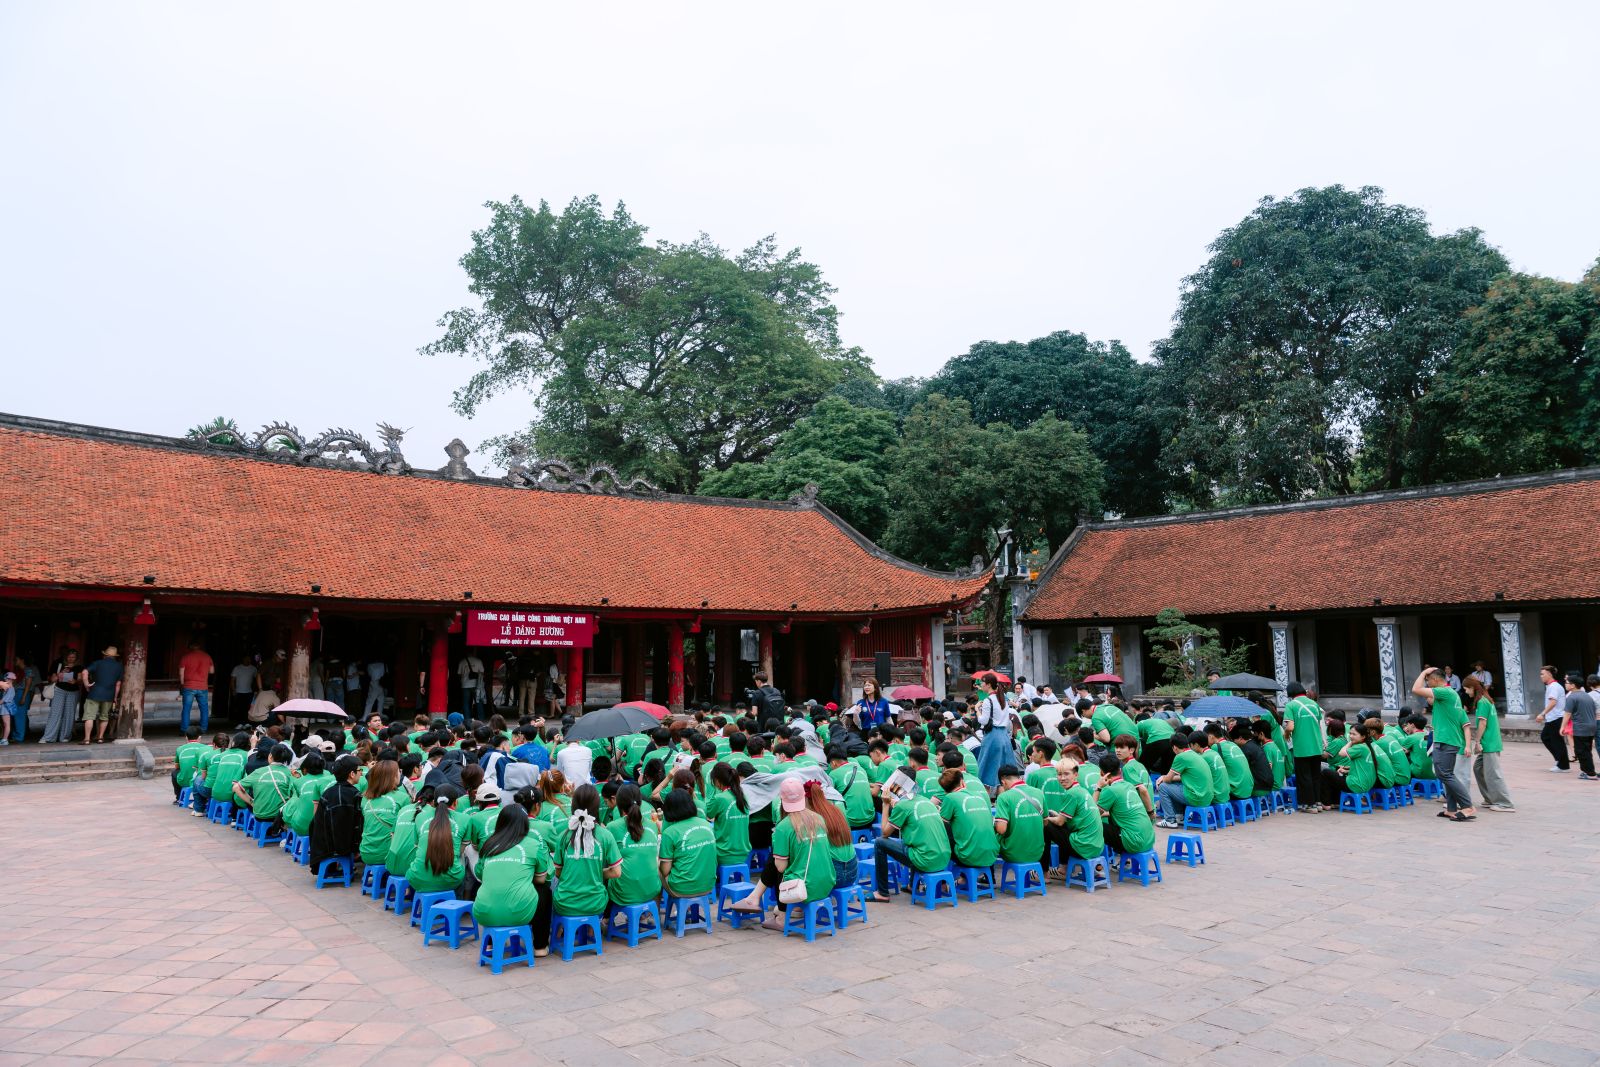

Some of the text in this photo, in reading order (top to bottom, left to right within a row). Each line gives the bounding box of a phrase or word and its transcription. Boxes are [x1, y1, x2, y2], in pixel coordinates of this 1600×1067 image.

[478, 612, 497, 620] TRƯỜNG
[512, 612, 525, 622] ĐẲNG
[528, 614, 541, 623] CÔNG
[543, 615, 561, 623] THƯƠNG
[563, 616, 573, 624] VIỆT
[501, 623, 564, 636] LỄ DÂNG HƯƠNG
